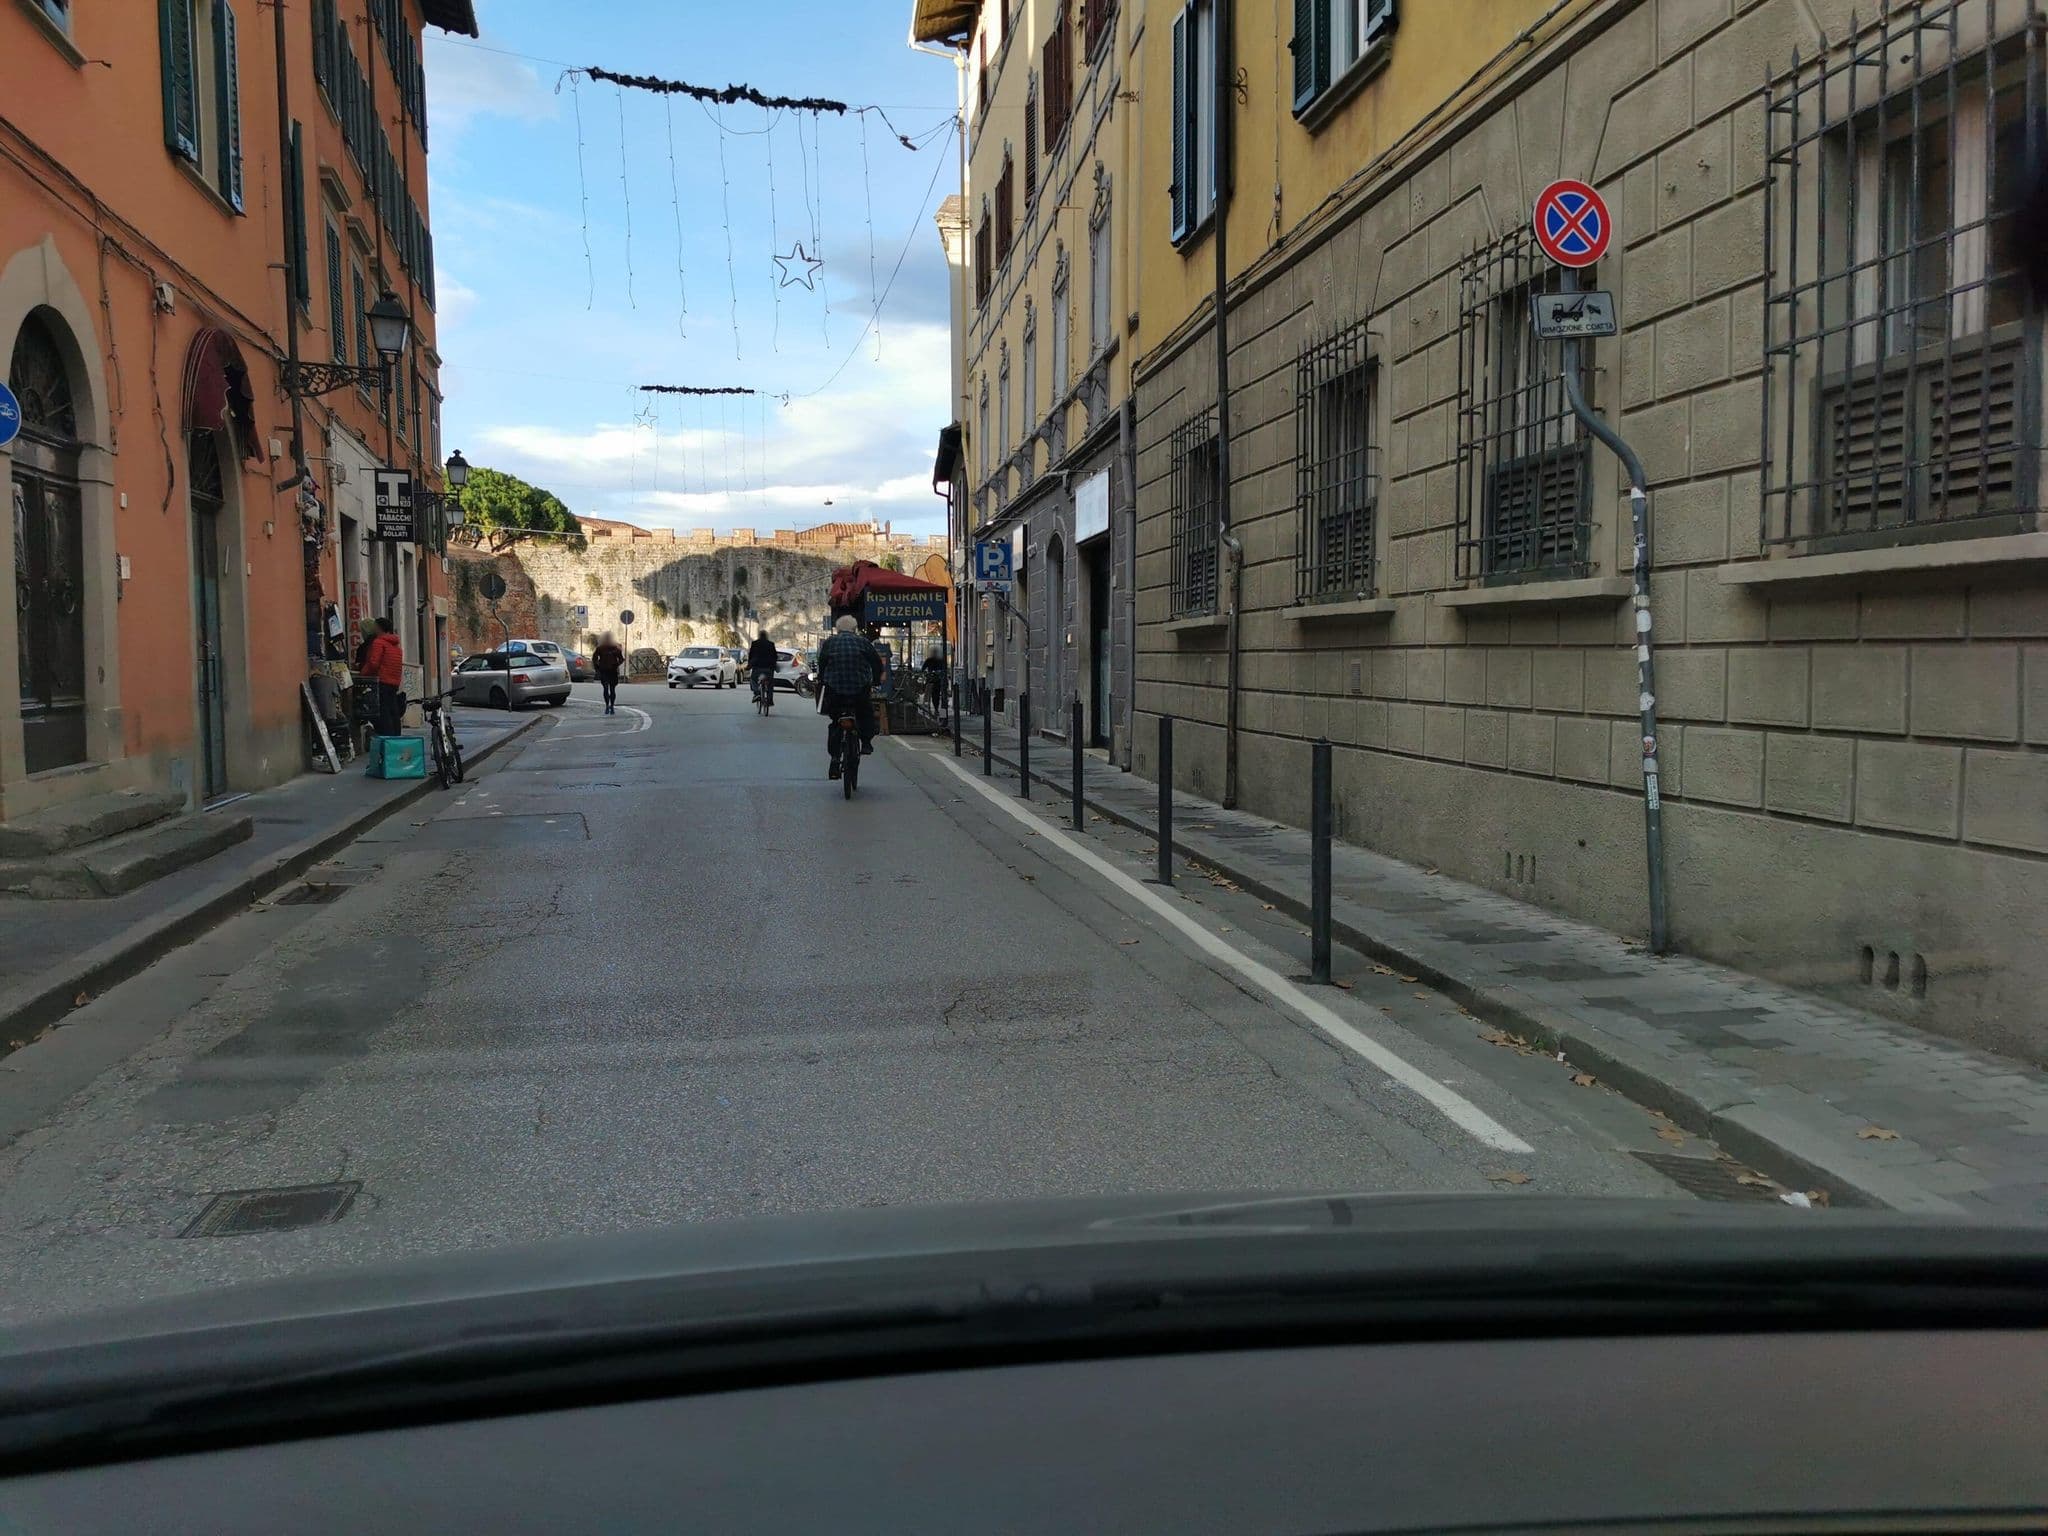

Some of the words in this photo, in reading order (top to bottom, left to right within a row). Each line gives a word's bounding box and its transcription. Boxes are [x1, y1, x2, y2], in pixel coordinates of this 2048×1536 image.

[1541, 324, 1583, 333] RIMOZIONE
[1586, 323, 1613, 331] COATTA
[378, 473, 409, 507] T
[378, 513, 412, 522] TABACCHI
[982, 545, 1005, 575] P
[866, 591, 943, 602] RISTORANTE
[877, 606, 933, 617] PIZZERIA
